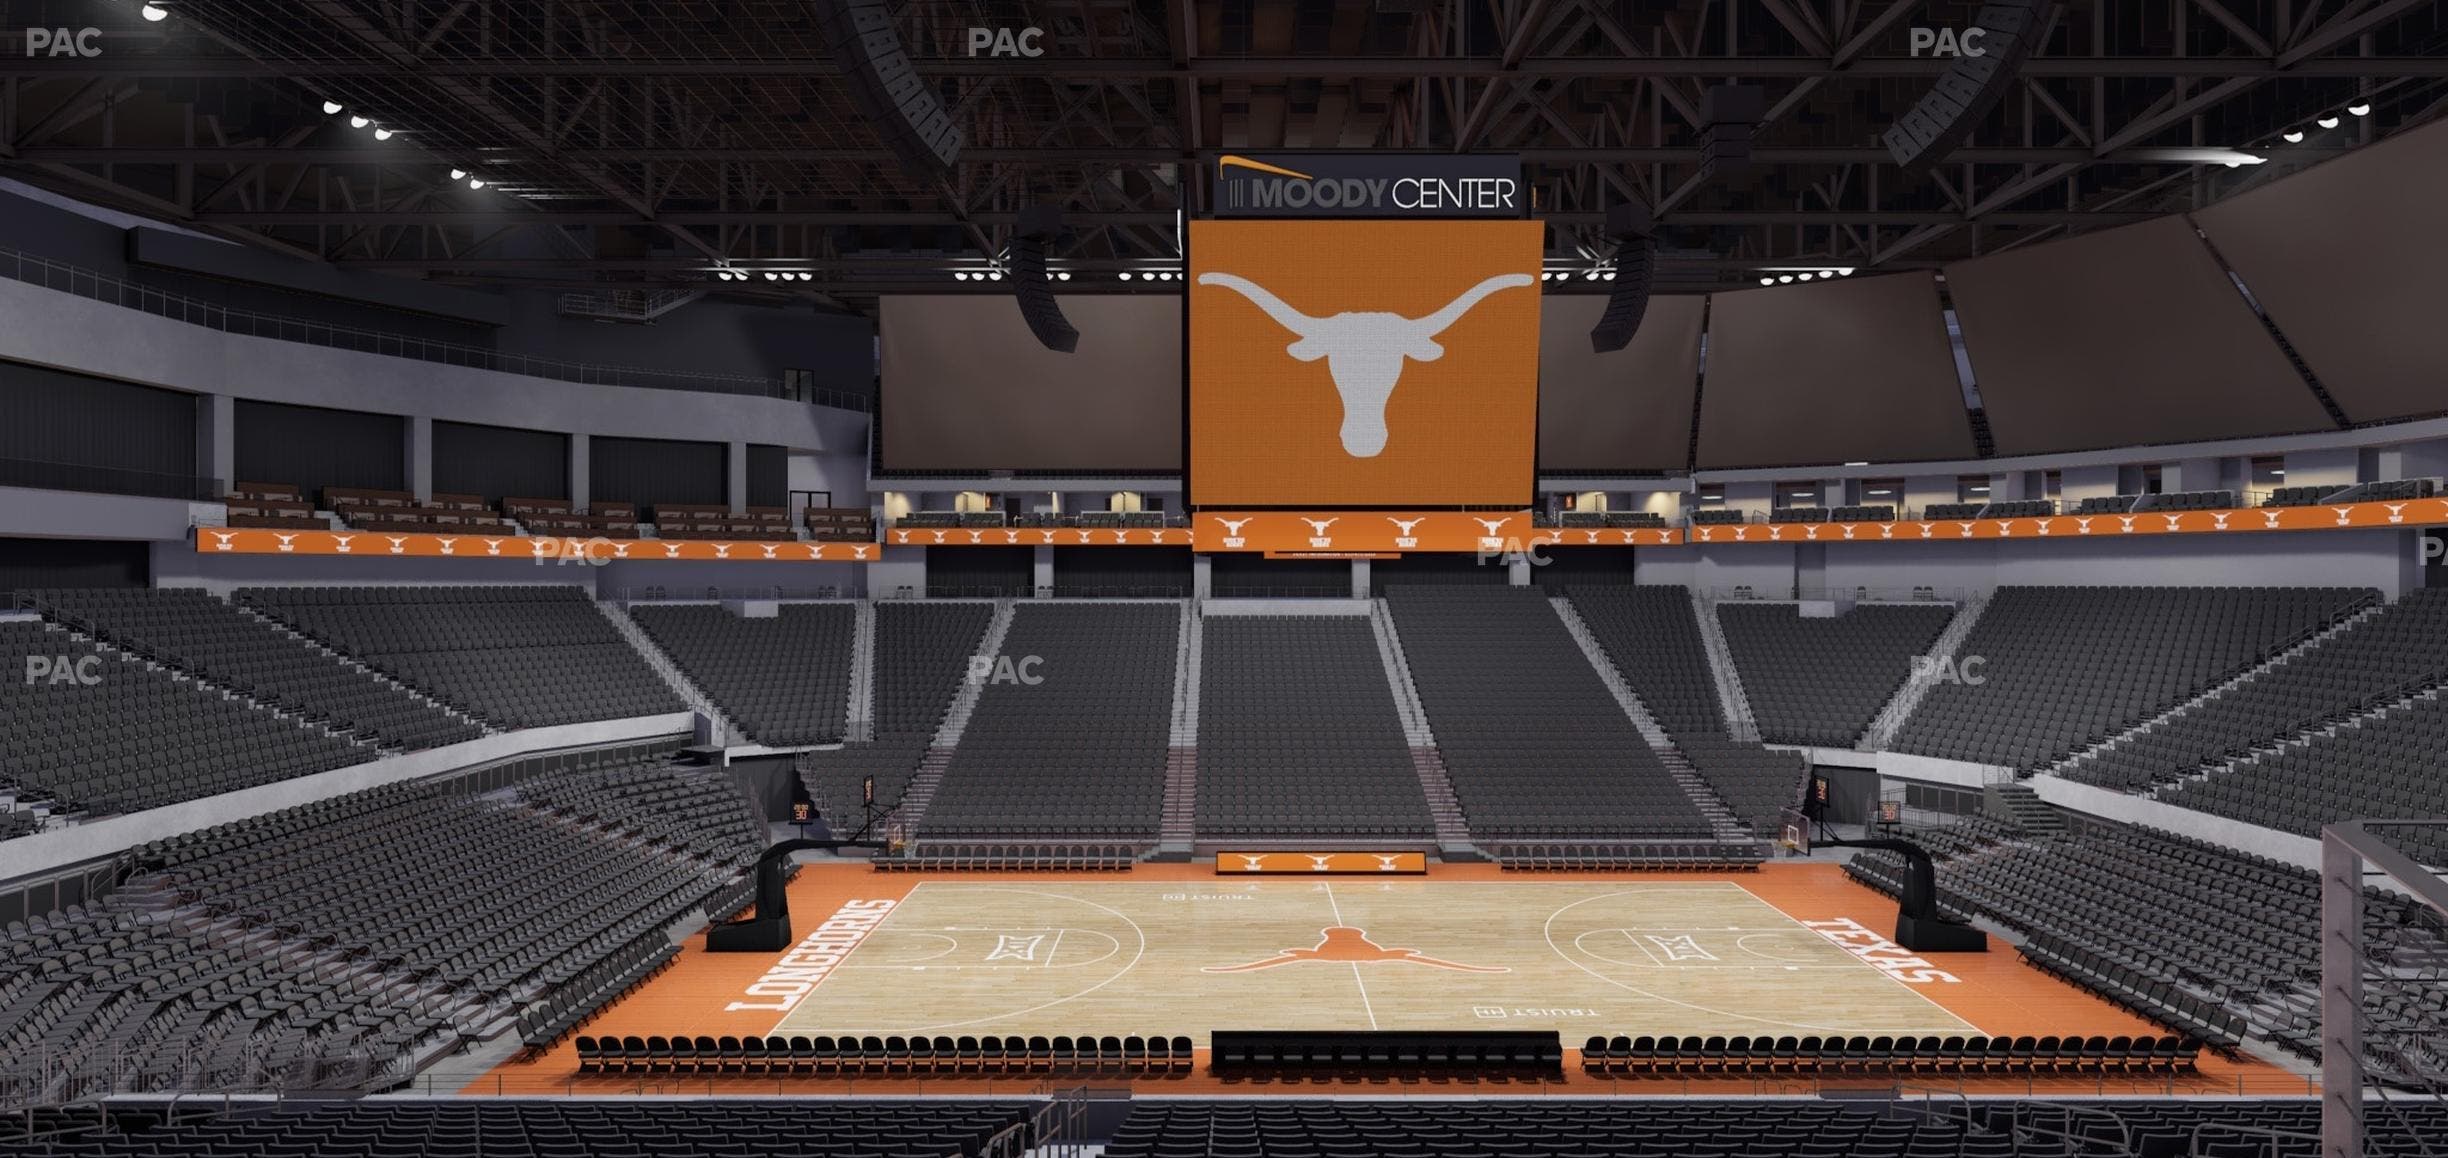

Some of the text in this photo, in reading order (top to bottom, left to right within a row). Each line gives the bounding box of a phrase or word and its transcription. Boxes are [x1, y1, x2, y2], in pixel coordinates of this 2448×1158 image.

[1253, 178, 1516, 208] MOODY CENTER
[724, 899, 898, 1012] LONGHORNS
[1801, 917, 1963, 983] TEXAS
